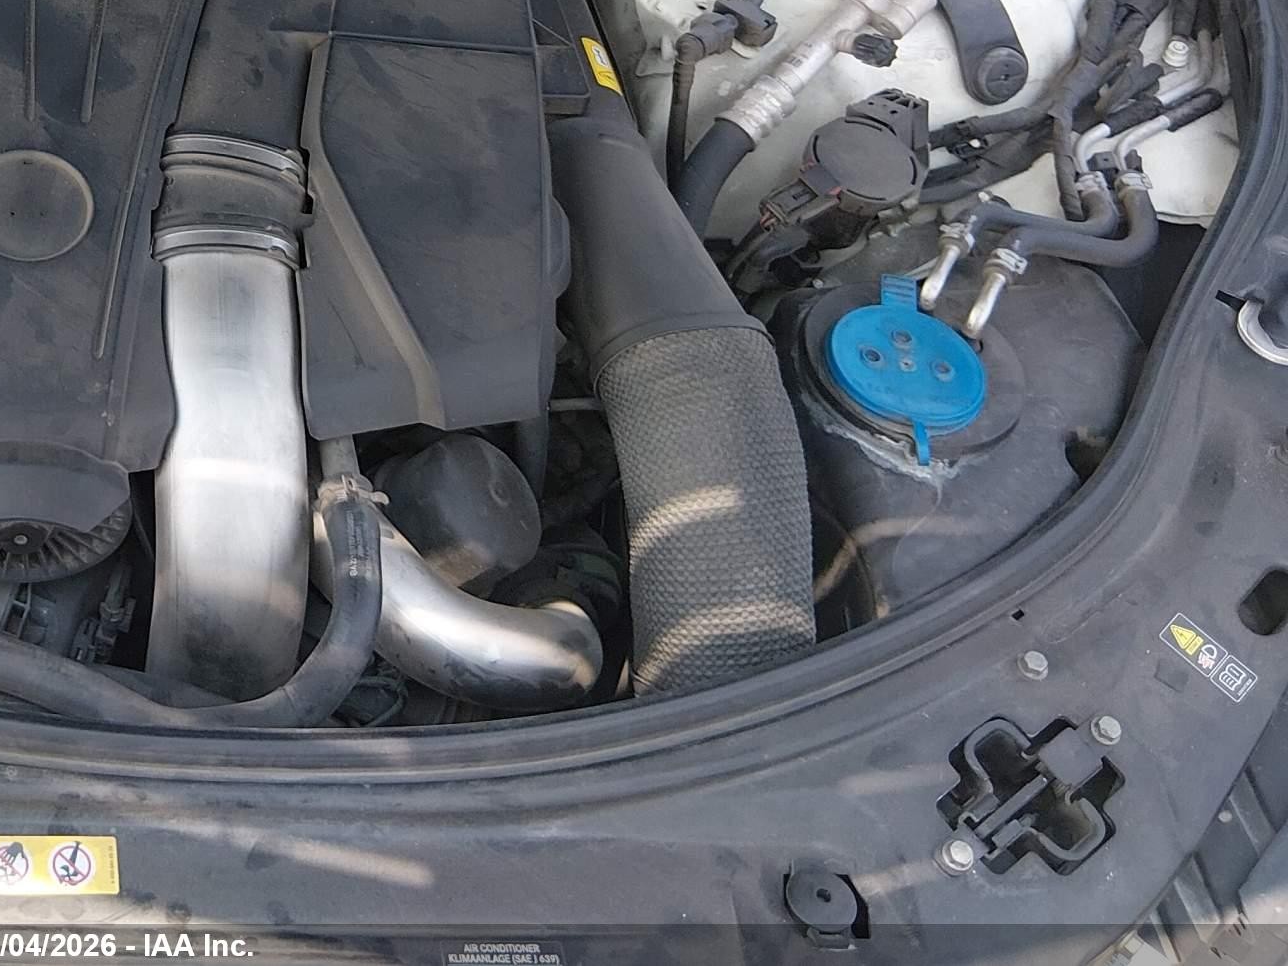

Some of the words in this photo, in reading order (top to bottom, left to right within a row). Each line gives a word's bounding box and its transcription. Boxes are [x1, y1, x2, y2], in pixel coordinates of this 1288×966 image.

[463, 943, 479, 953] AIR
[479, 943, 541, 953] CONDITIONER
[448, 953, 512, 964] KLIMAANLAGE
